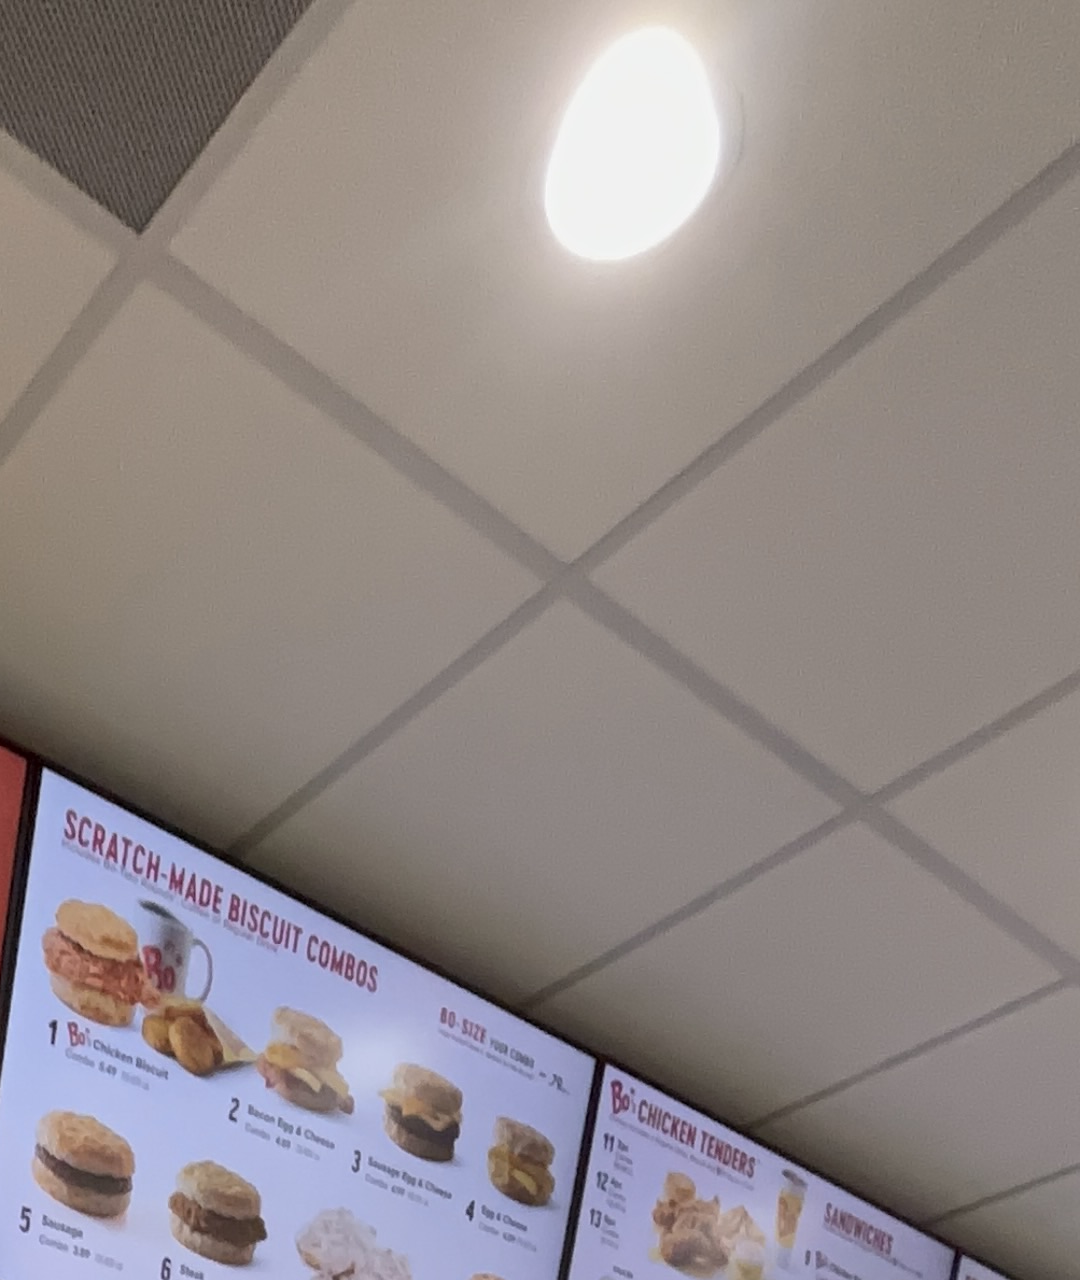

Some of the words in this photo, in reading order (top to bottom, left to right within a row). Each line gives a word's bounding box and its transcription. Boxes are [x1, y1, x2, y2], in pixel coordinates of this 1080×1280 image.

[62, 808, 224, 914] SCRATCH-MADE
[227, 892, 304, 955] BISCUIT
[306, 934, 380, 994] COMBOS
[48, 1020, 58, 1046] 1
[92, 1039, 134, 1065] Chicken
[135, 1055, 170, 1081] Biscuit
[228, 1096, 240, 1123] 2
[247, 1103, 276, 1123] Bacon
[603, 1131, 616, 1154] 11
[637, 1098, 698, 1149] CHICKEN
[700, 1129, 757, 1180] TENDERS
[351, 1149, 362, 1174] 3
[595, 1170, 610, 1192] 12
[18, 1205, 32, 1234] 5
[40, 1213, 85, 1240] Sausage
[465, 1199, 476, 1223] 4
[588, 1207, 603, 1229] 13
[823, 1201, 895, 1256] SANDWICHES
